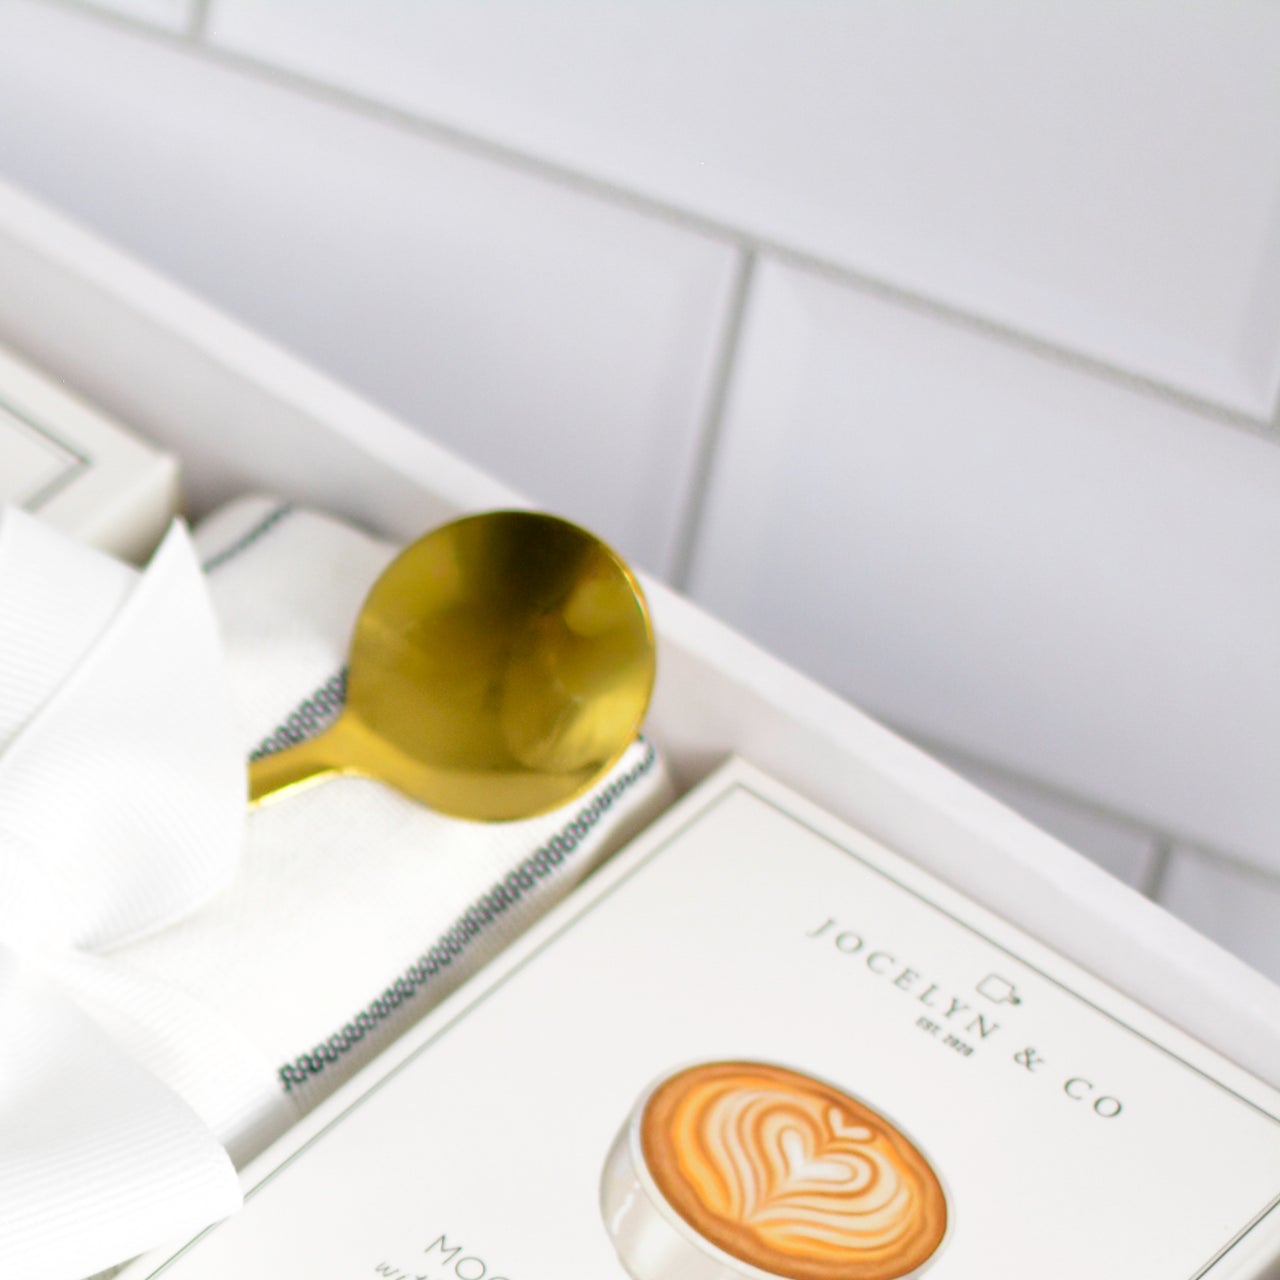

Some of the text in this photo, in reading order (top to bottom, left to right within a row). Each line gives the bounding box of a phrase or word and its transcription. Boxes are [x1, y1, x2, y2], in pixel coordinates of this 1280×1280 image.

[806, 917, 1122, 1118] JOCELYN & CO
